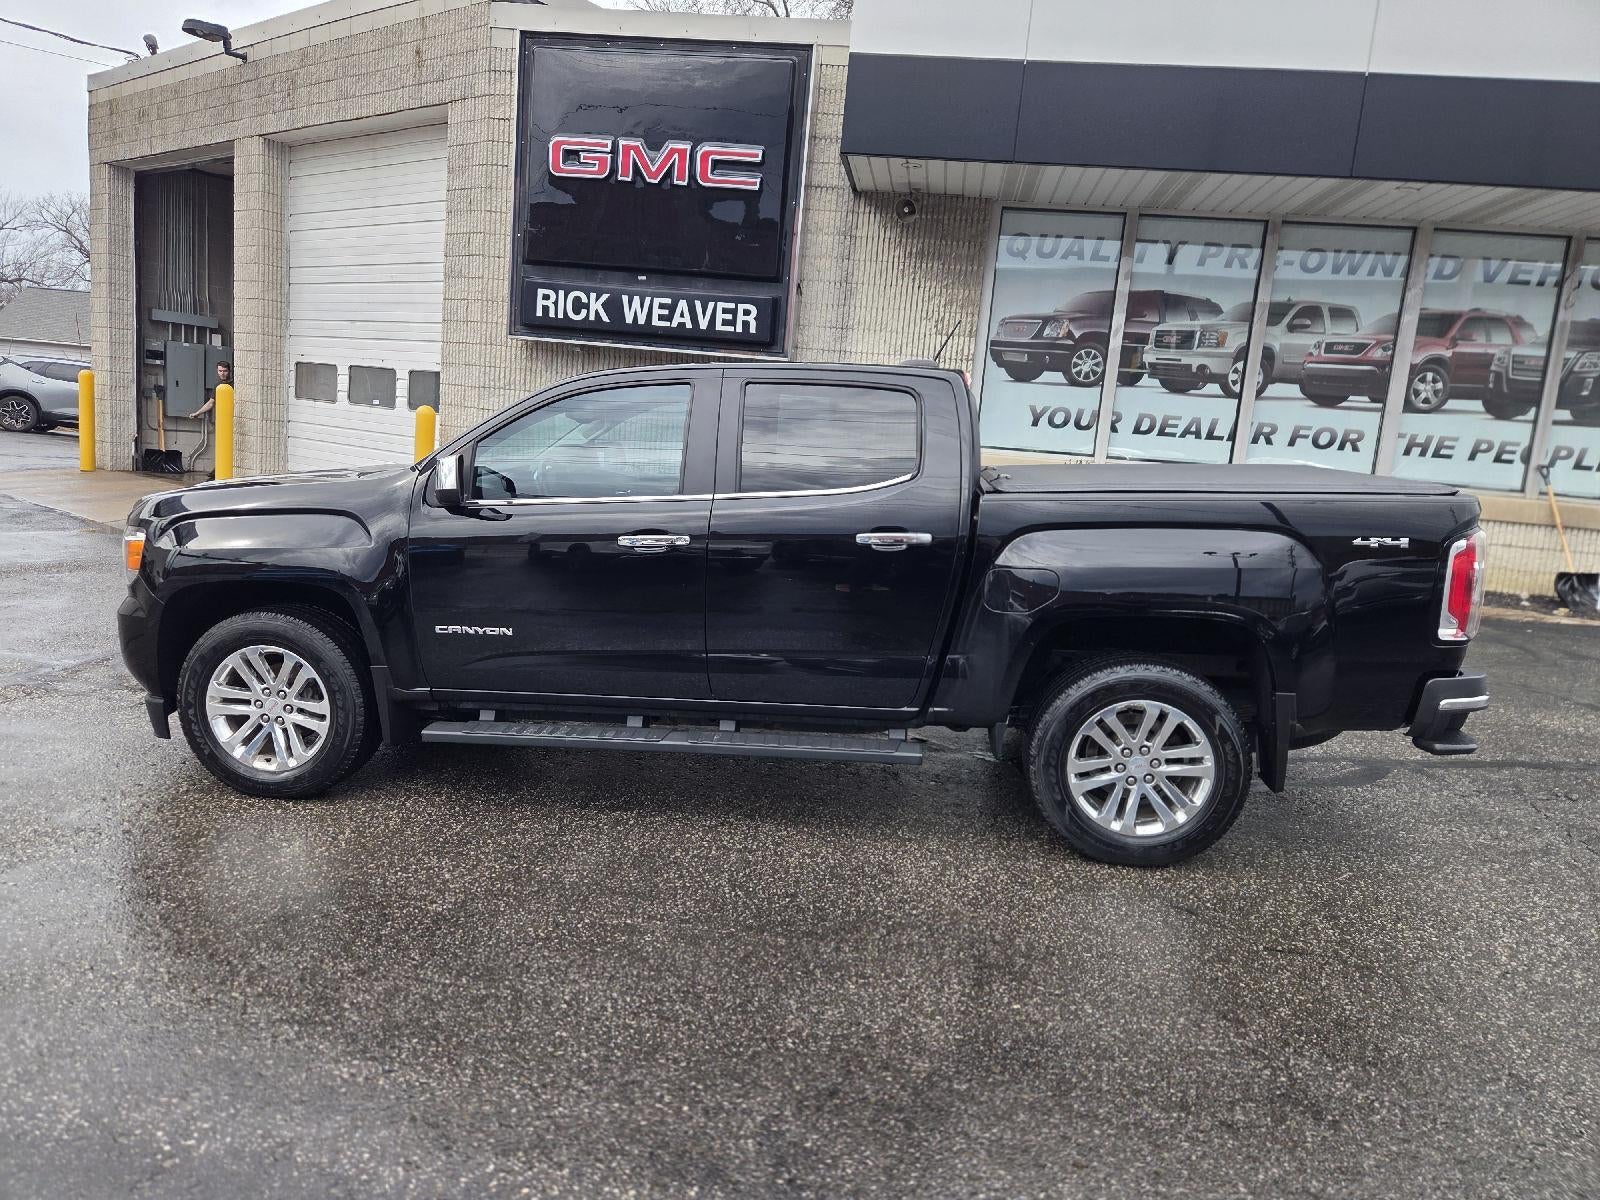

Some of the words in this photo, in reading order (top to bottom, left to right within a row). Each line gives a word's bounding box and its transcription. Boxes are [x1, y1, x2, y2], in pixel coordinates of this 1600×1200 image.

[548, 133, 766, 191] GMC
[1005, 231, 1188, 266] QUALTY
[535, 288, 611, 324] RICK
[621, 294, 758, 334] WEAVER
[1287, 424, 1366, 453] FOR
[1397, 432, 1460, 460] HE
[434, 625, 513, 636] CANYON
